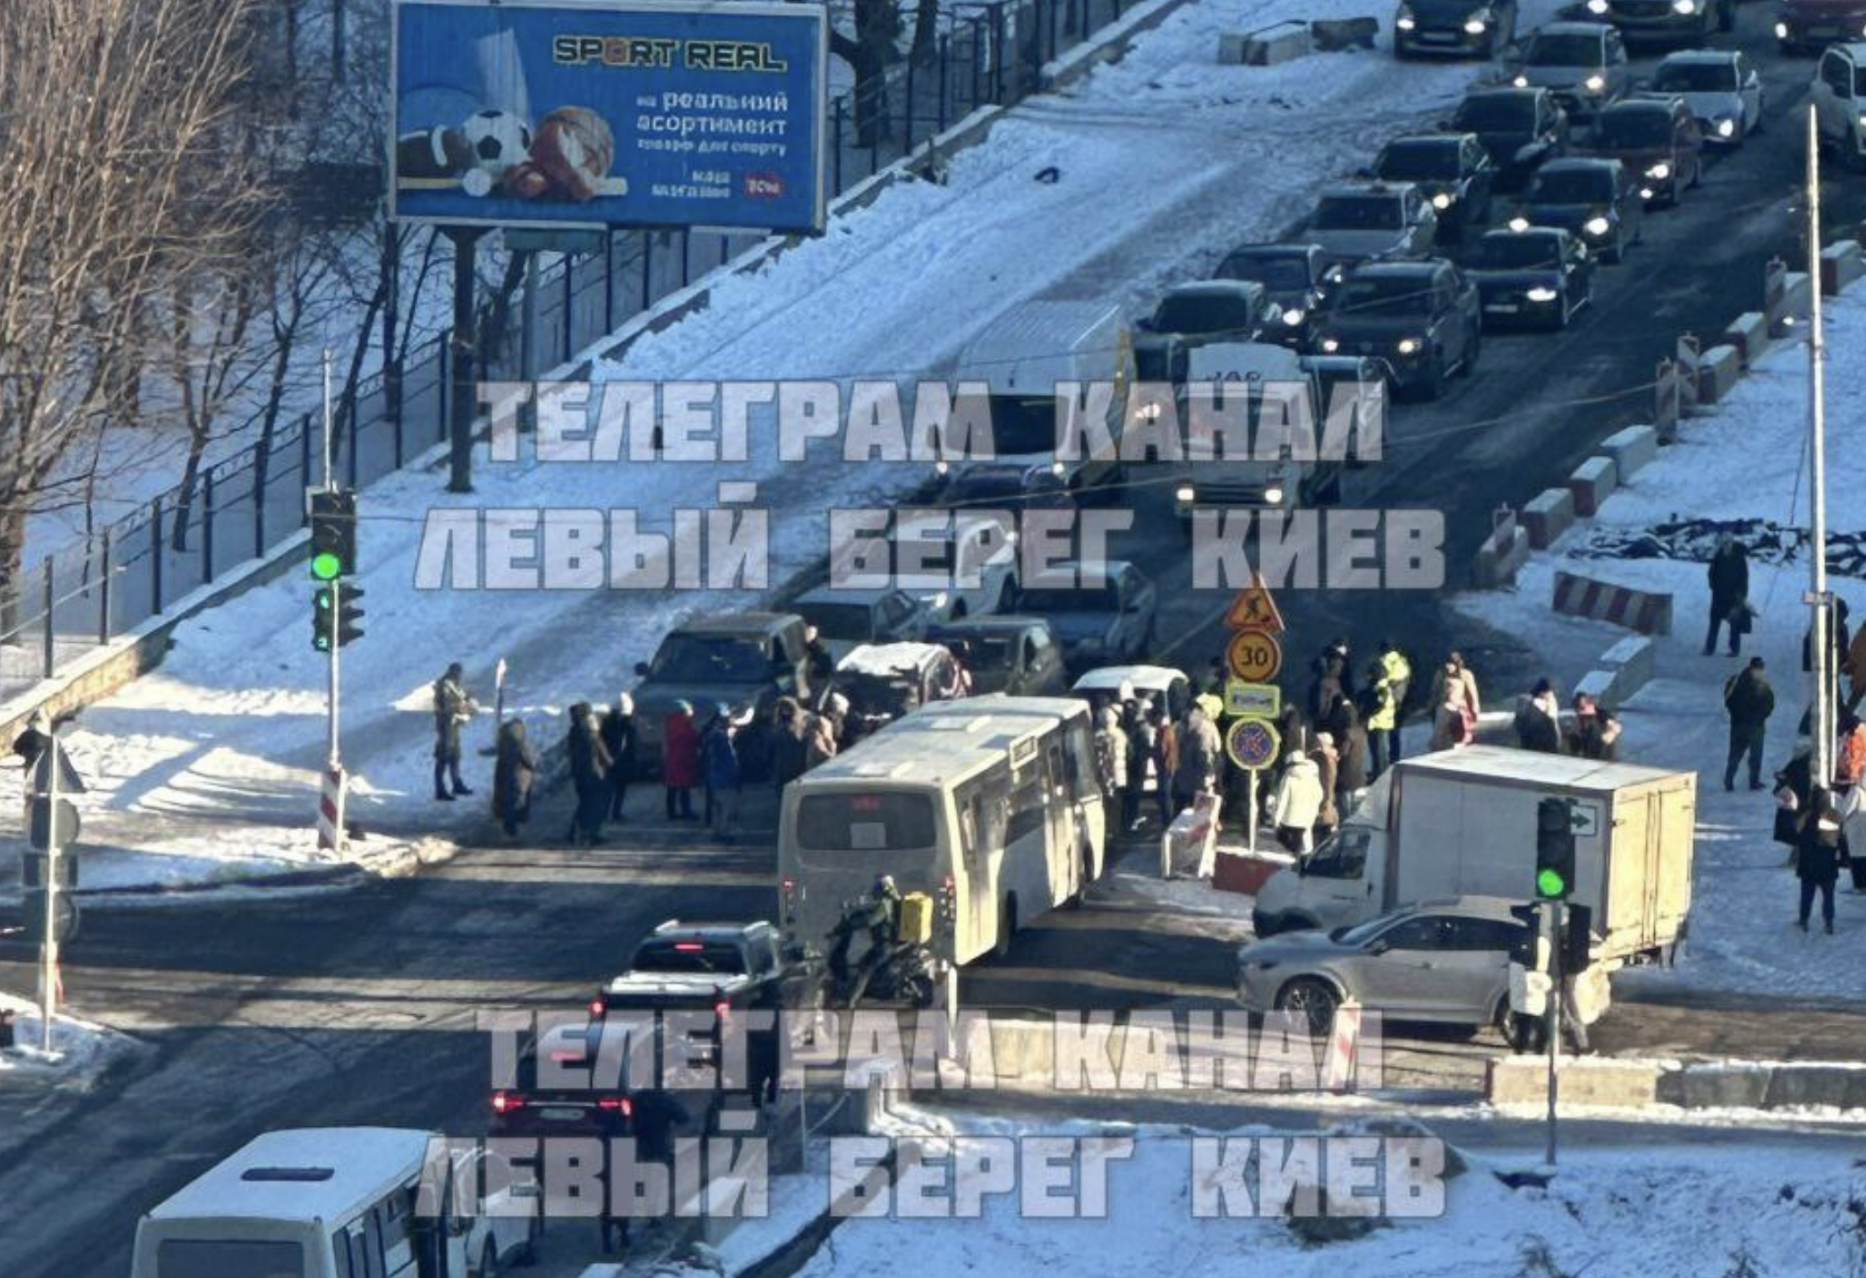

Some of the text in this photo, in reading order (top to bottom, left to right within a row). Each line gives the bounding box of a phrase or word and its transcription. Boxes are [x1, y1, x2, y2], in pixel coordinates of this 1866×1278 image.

[553, 35, 787, 72] SPORT REAL
[663, 92, 788, 112] реальний
[637, 114, 787, 136] асортимент
[1241, 645, 1268, 667] 30
